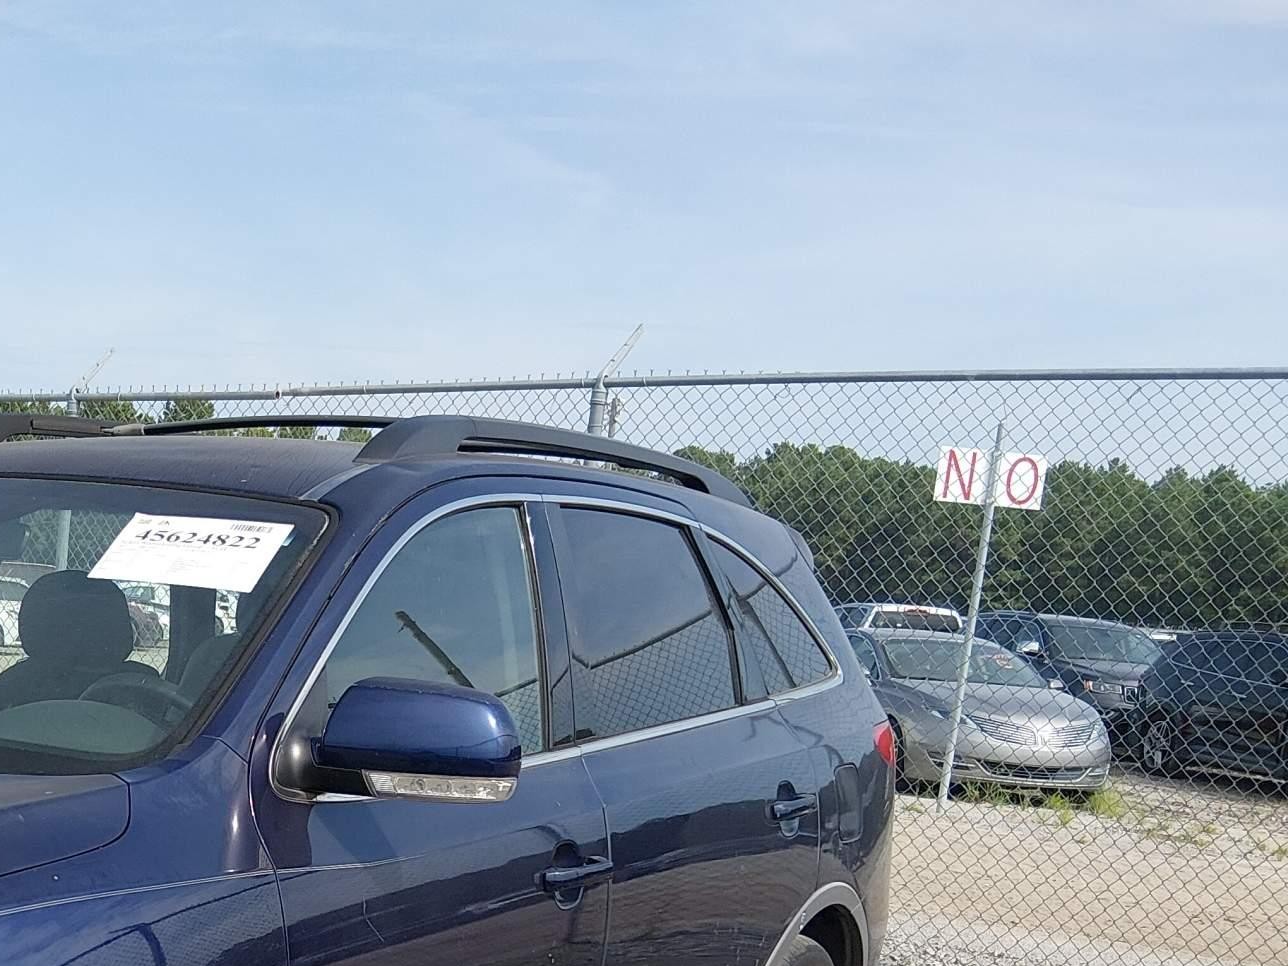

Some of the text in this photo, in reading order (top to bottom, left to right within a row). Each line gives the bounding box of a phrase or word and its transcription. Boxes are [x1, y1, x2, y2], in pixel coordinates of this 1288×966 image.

[942, 448, 1039, 506] N O
[134, 528, 262, 549] 45624822
